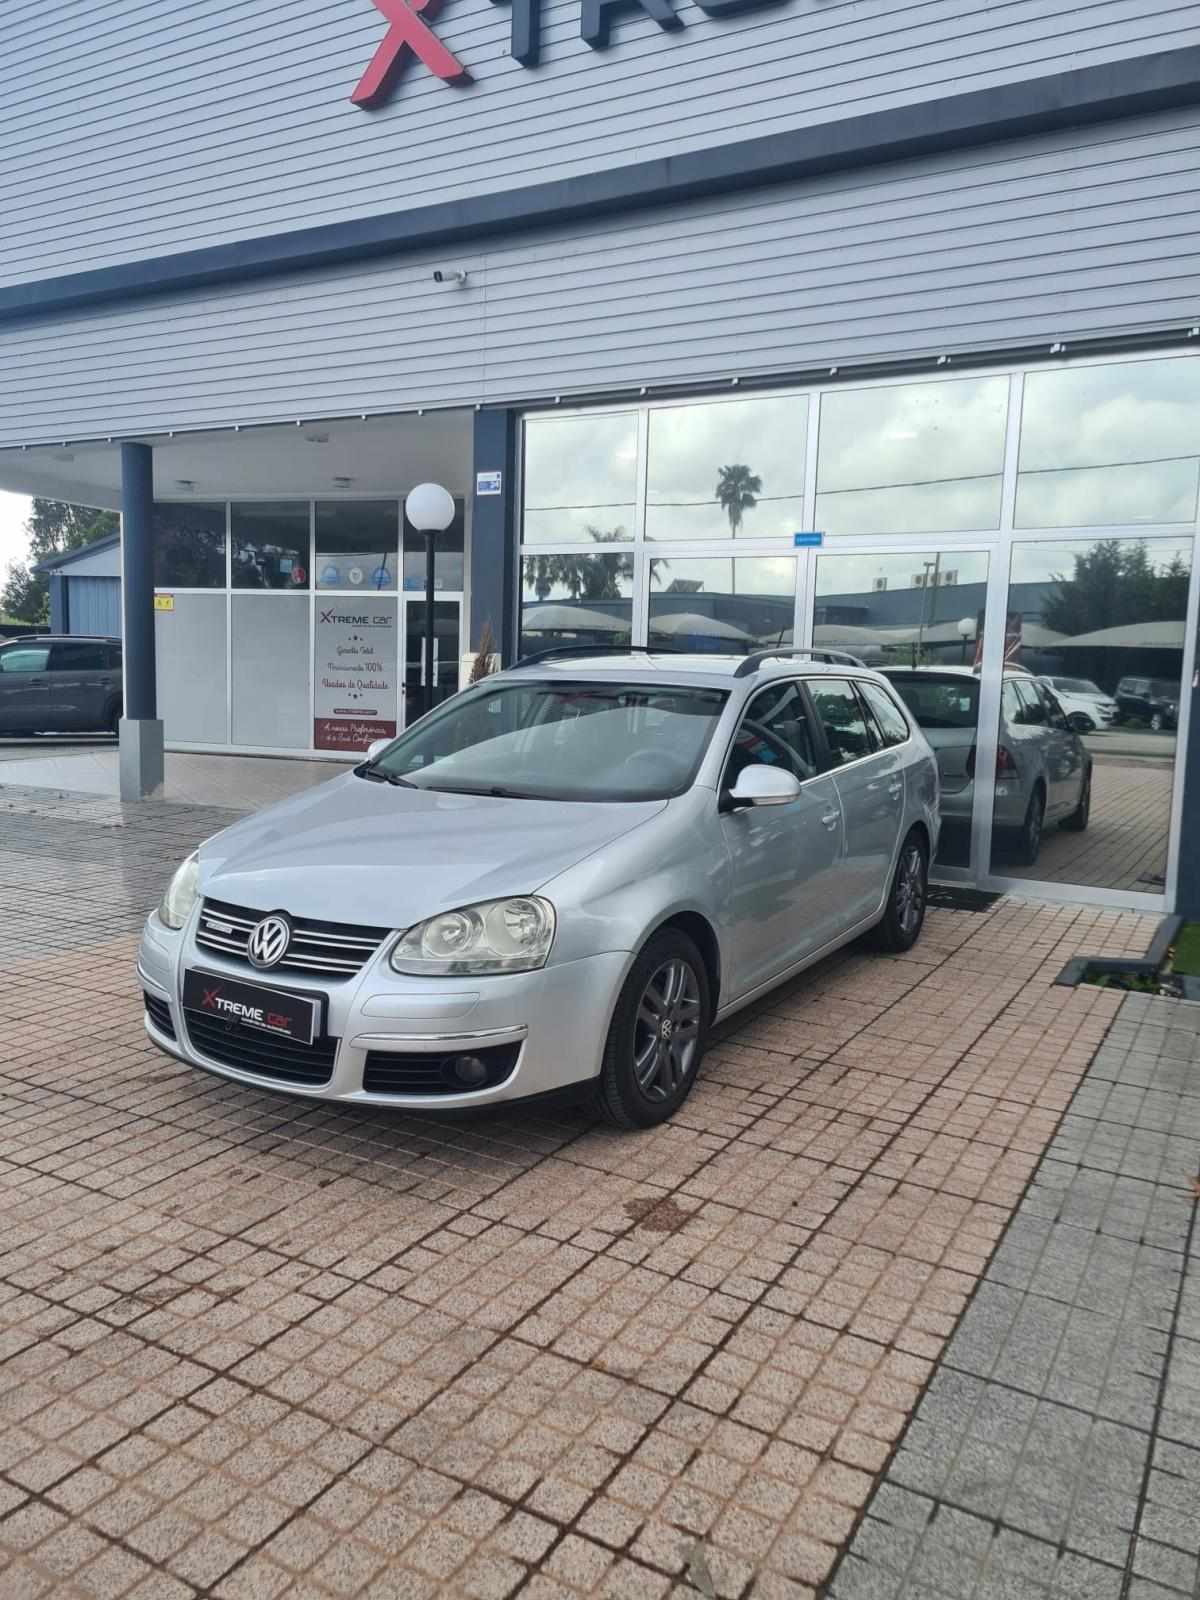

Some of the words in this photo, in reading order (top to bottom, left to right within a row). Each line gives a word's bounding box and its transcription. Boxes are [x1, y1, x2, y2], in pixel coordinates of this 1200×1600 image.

[320, 608, 369, 624] XTREME
[251, 917, 289, 966] VW
[202, 984, 264, 1021] XTREME
